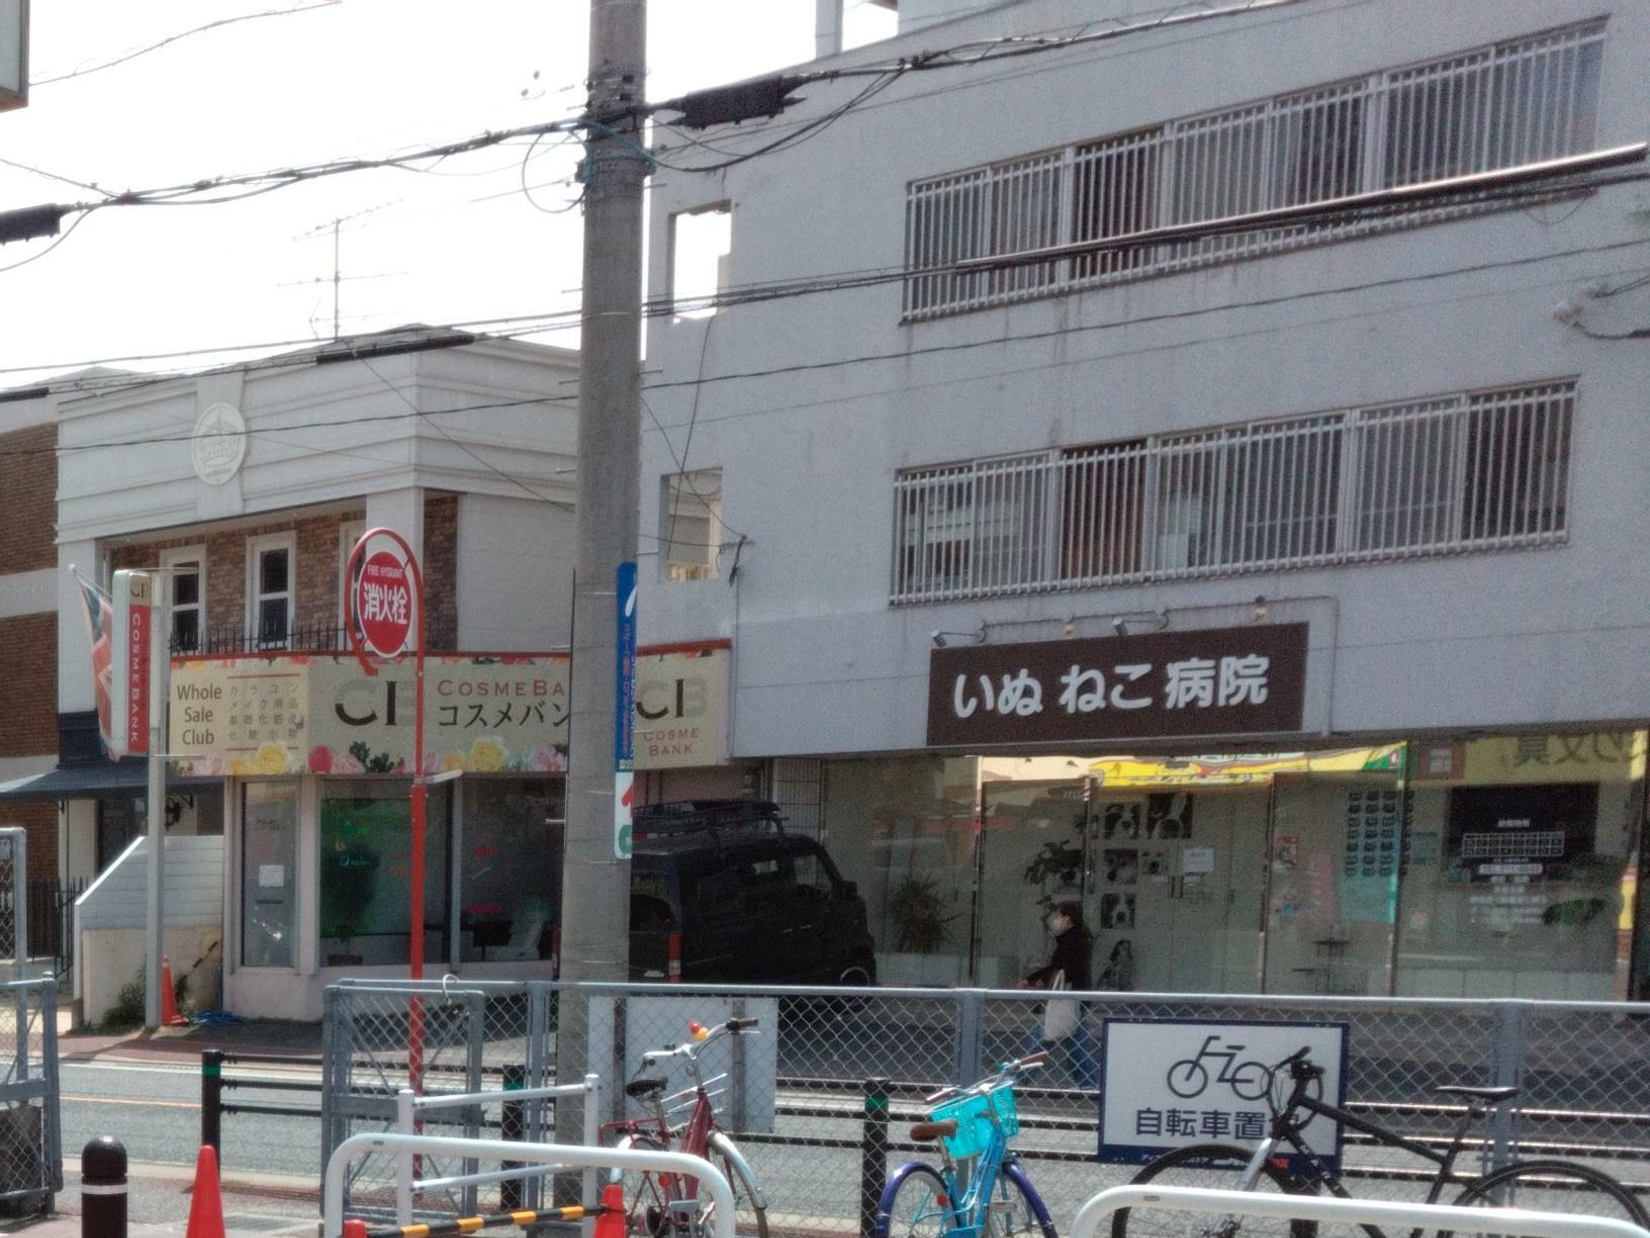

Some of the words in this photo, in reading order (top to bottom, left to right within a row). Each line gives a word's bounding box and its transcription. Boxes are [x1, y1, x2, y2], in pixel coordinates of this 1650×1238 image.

[367, 564, 379, 576] FIRE
[363, 581, 408, 625] 消火栓
[176, 683, 222, 700] Whole
[954, 668, 1044, 719] いぬ
[1059, 664, 1153, 714] ねこ
[1164, 653, 1270, 710] 病院
[184, 707, 214, 723] Sale
[182, 728, 215, 745] Club
[644, 727, 700, 742] COSME
[650, 744, 694, 757] BANK
